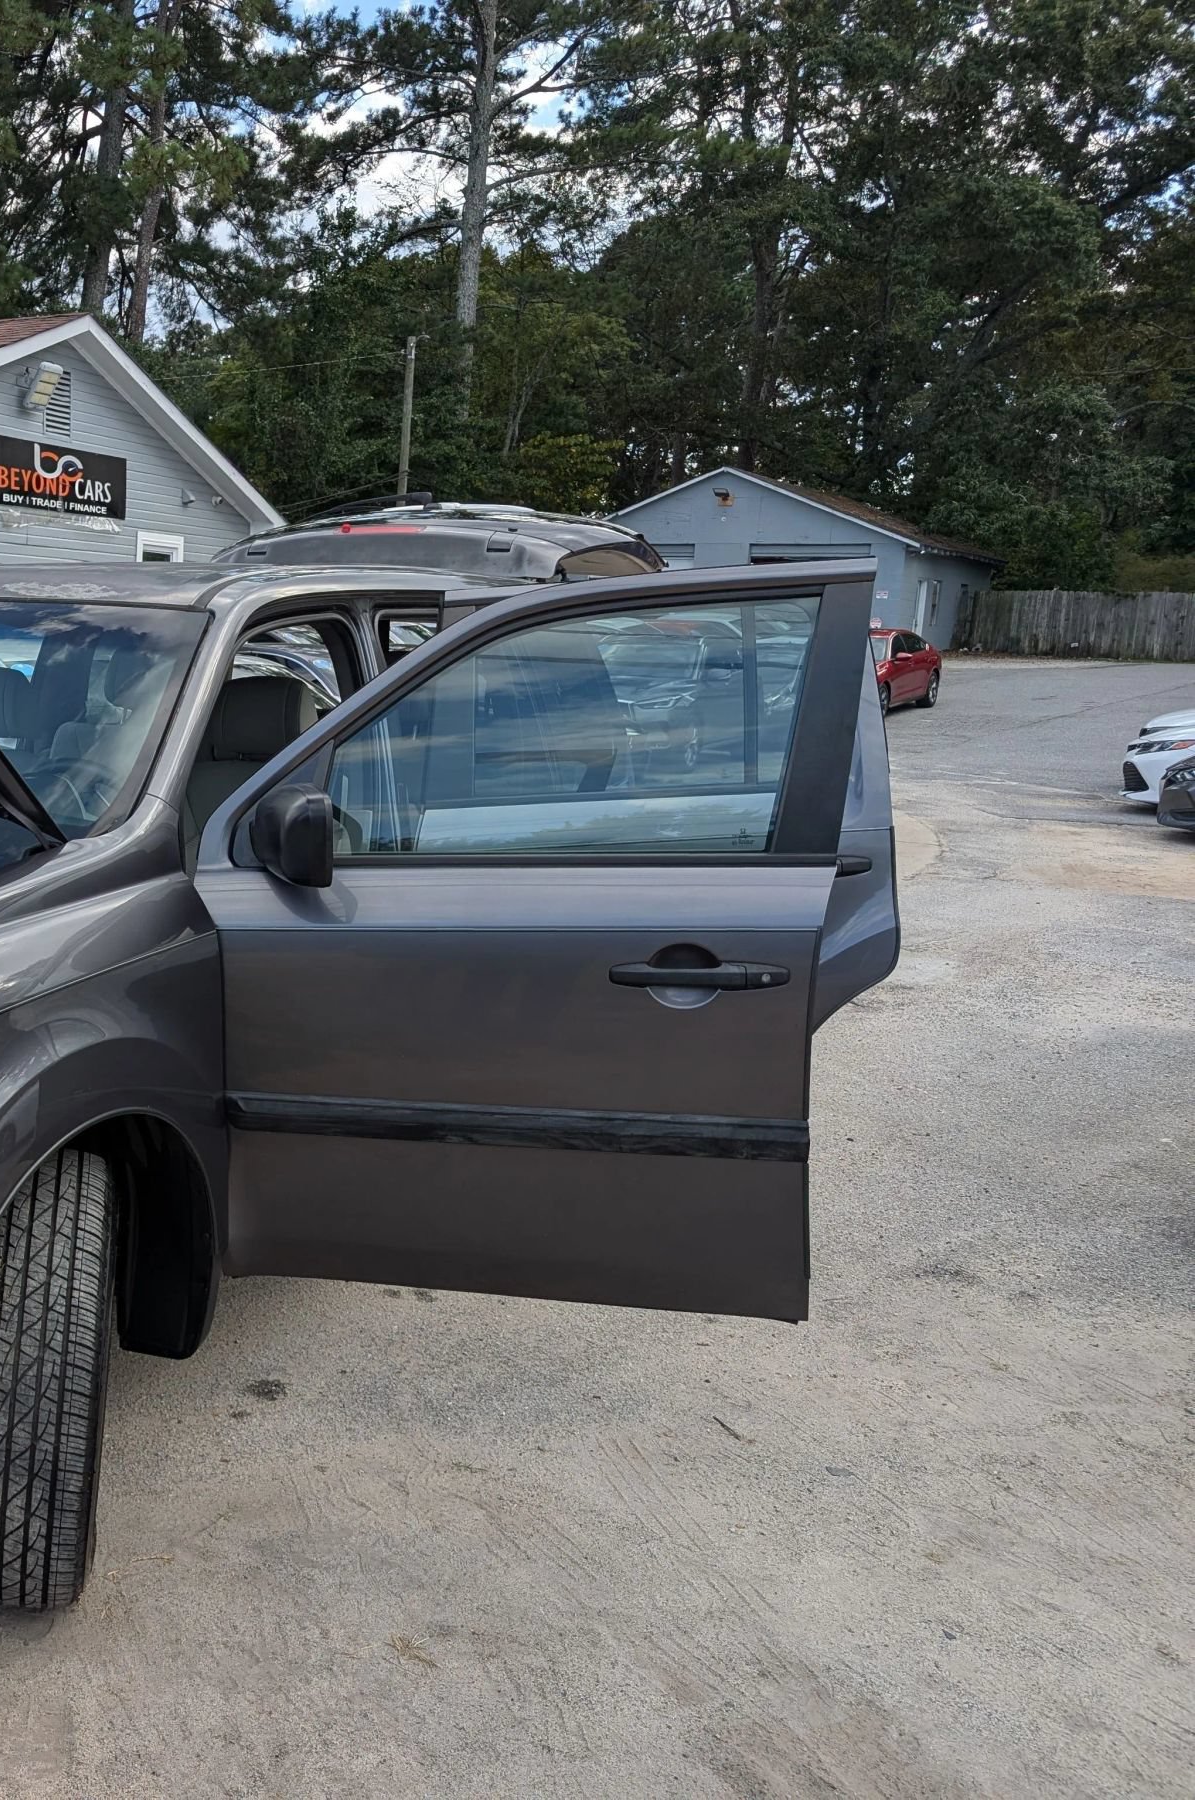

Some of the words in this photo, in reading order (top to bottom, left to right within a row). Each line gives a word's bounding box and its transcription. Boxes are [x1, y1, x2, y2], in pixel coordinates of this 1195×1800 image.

[75, 478, 112, 504] CARS
[2, 493, 24, 504] BUY
[31, 497, 63, 509] TRADE
[69, 503, 108, 515] FINANCE
